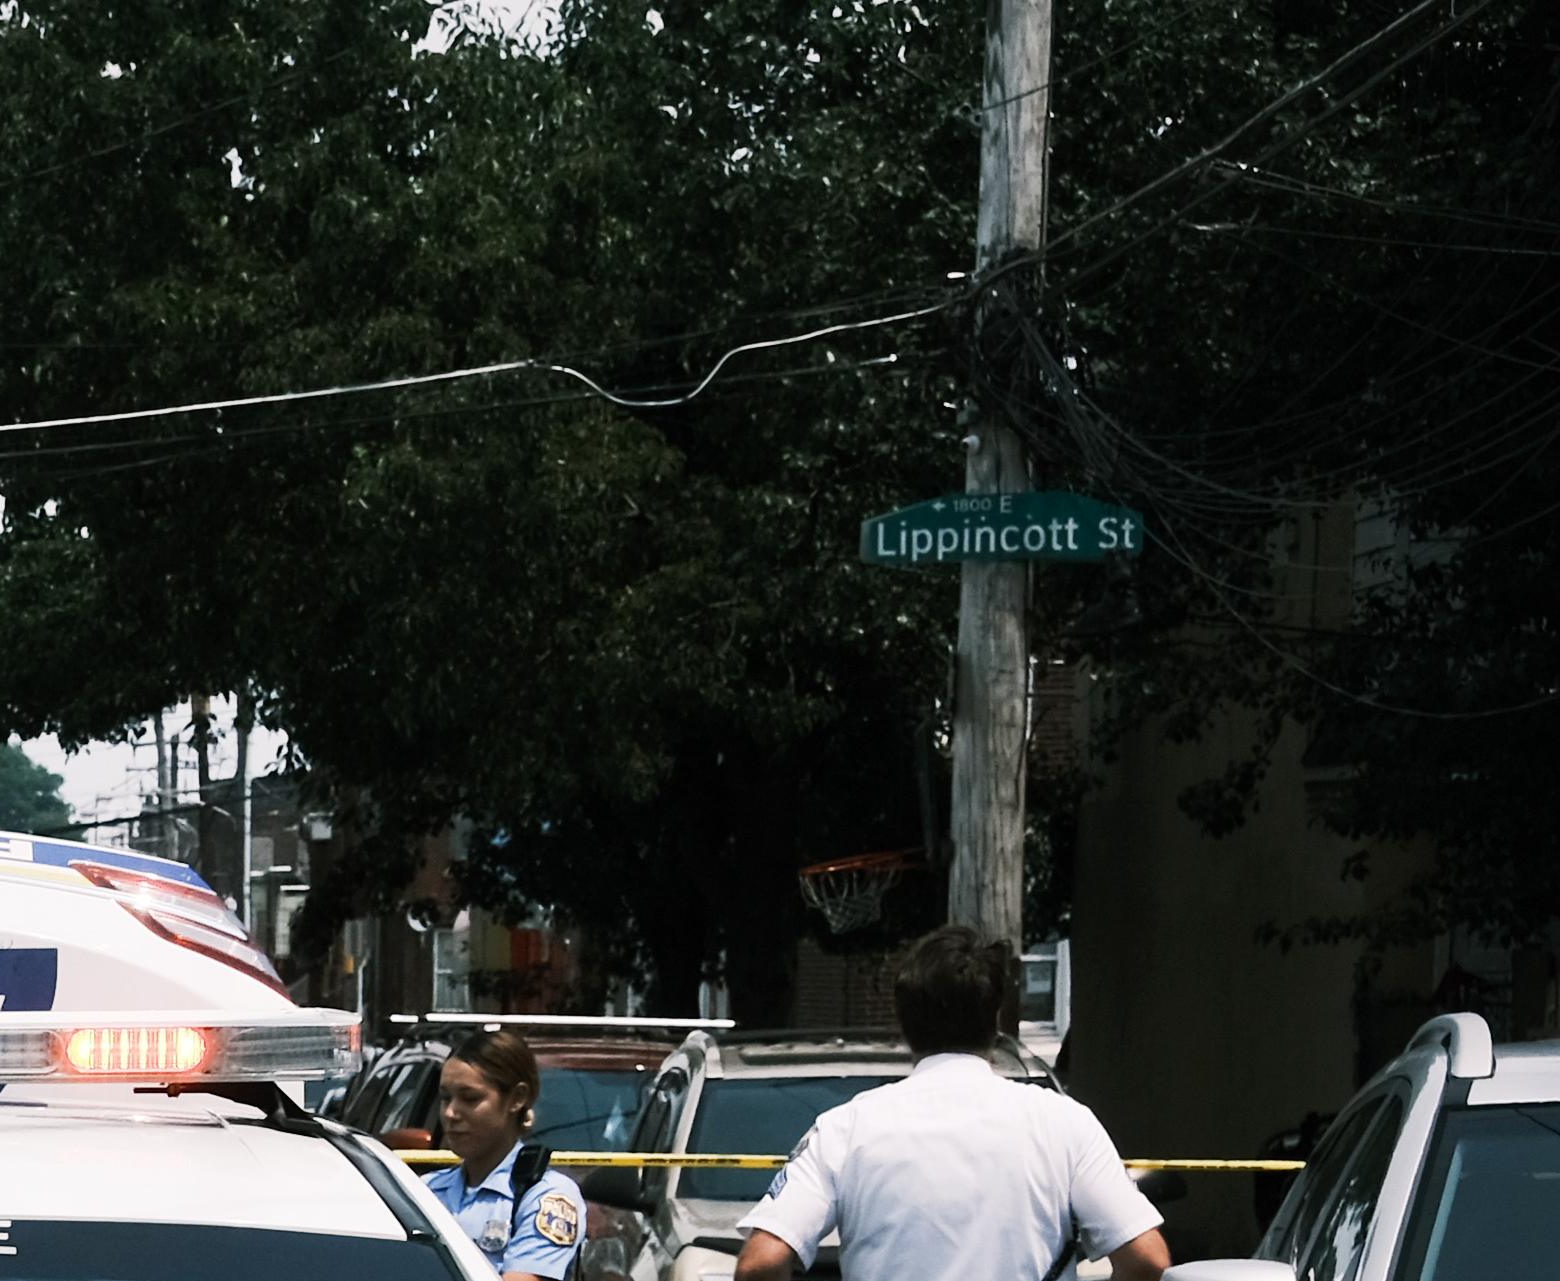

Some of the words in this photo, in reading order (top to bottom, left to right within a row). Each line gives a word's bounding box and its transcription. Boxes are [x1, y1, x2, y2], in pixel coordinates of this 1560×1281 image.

[953, 500, 992, 512] 1800
[1000, 496, 1012, 513] E
[877, 517, 1078, 561] Lippincott
[1098, 517, 1134, 549] St
